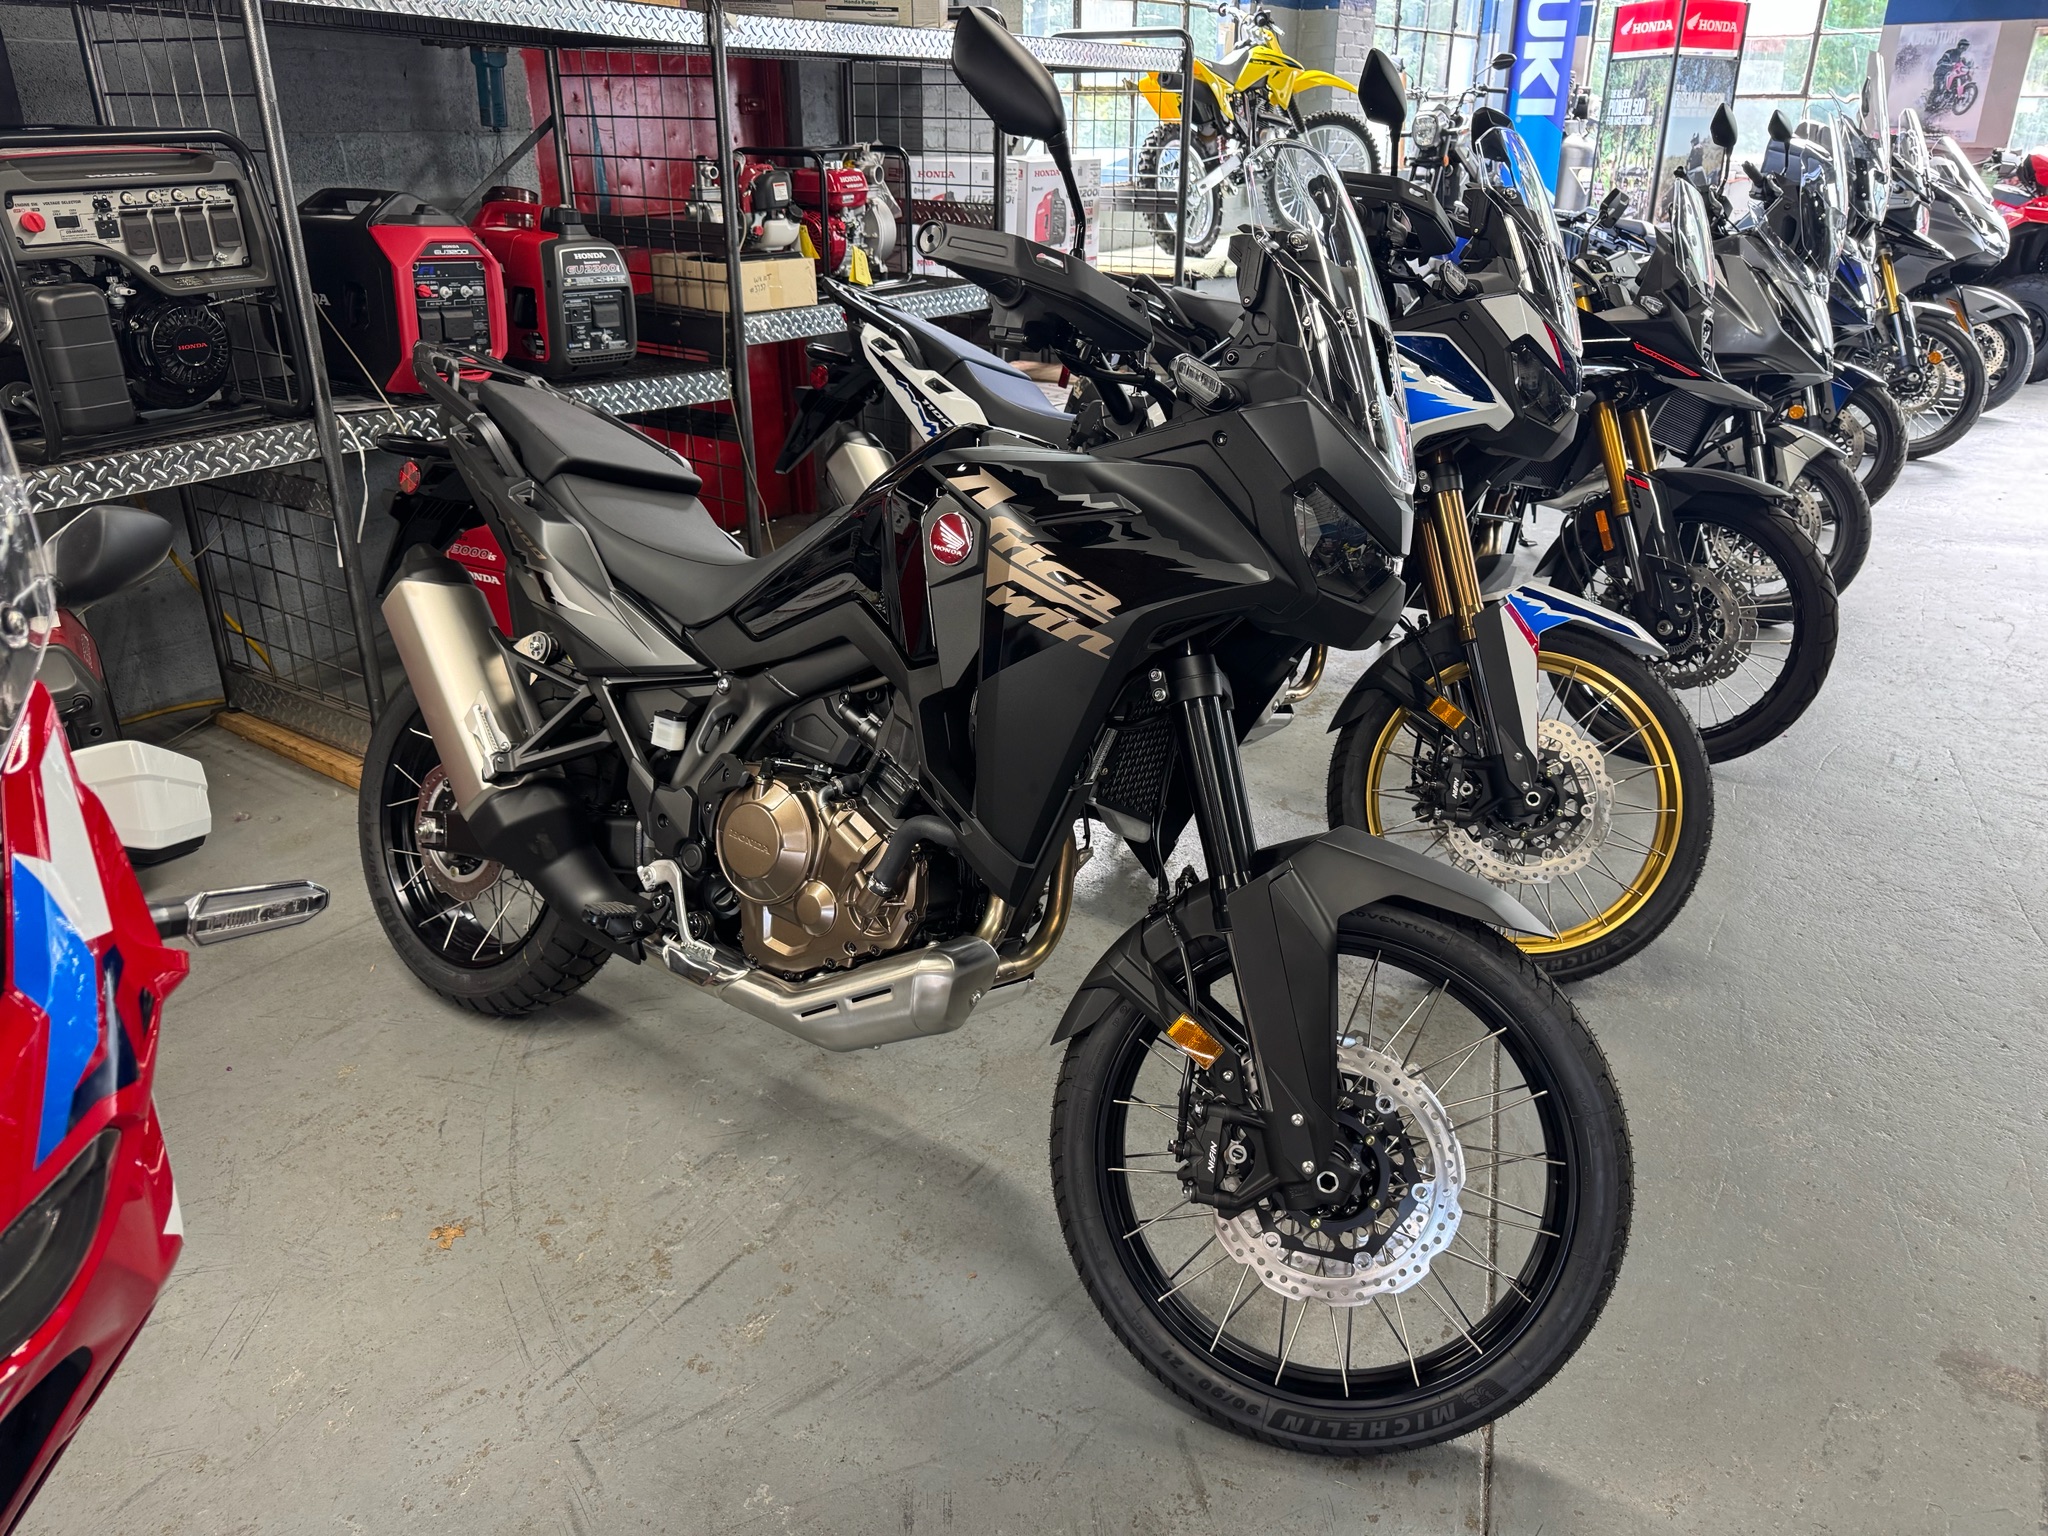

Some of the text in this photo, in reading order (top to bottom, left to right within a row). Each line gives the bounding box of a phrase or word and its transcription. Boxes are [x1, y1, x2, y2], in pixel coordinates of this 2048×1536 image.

[1631, 19, 1674, 35] HONDA
[1698, 19, 1739, 33] HONDA
[1632, 97, 1646, 116] 500
[840, 175, 863, 183] HONDA
[917, 170, 956, 178] HONDA
[1034, 169, 1060, 178] HONDA
[573, 252, 607, 260] HONDA
[565, 263, 621, 275] EU2200i
[178, 342, 208, 351] HONDA
[446, 543, 498, 562] 3000is
[933, 543, 963, 557] HONDA
[728, 827, 772, 856] HONDA
[1279, 1402, 1457, 1440] MICHELIN
